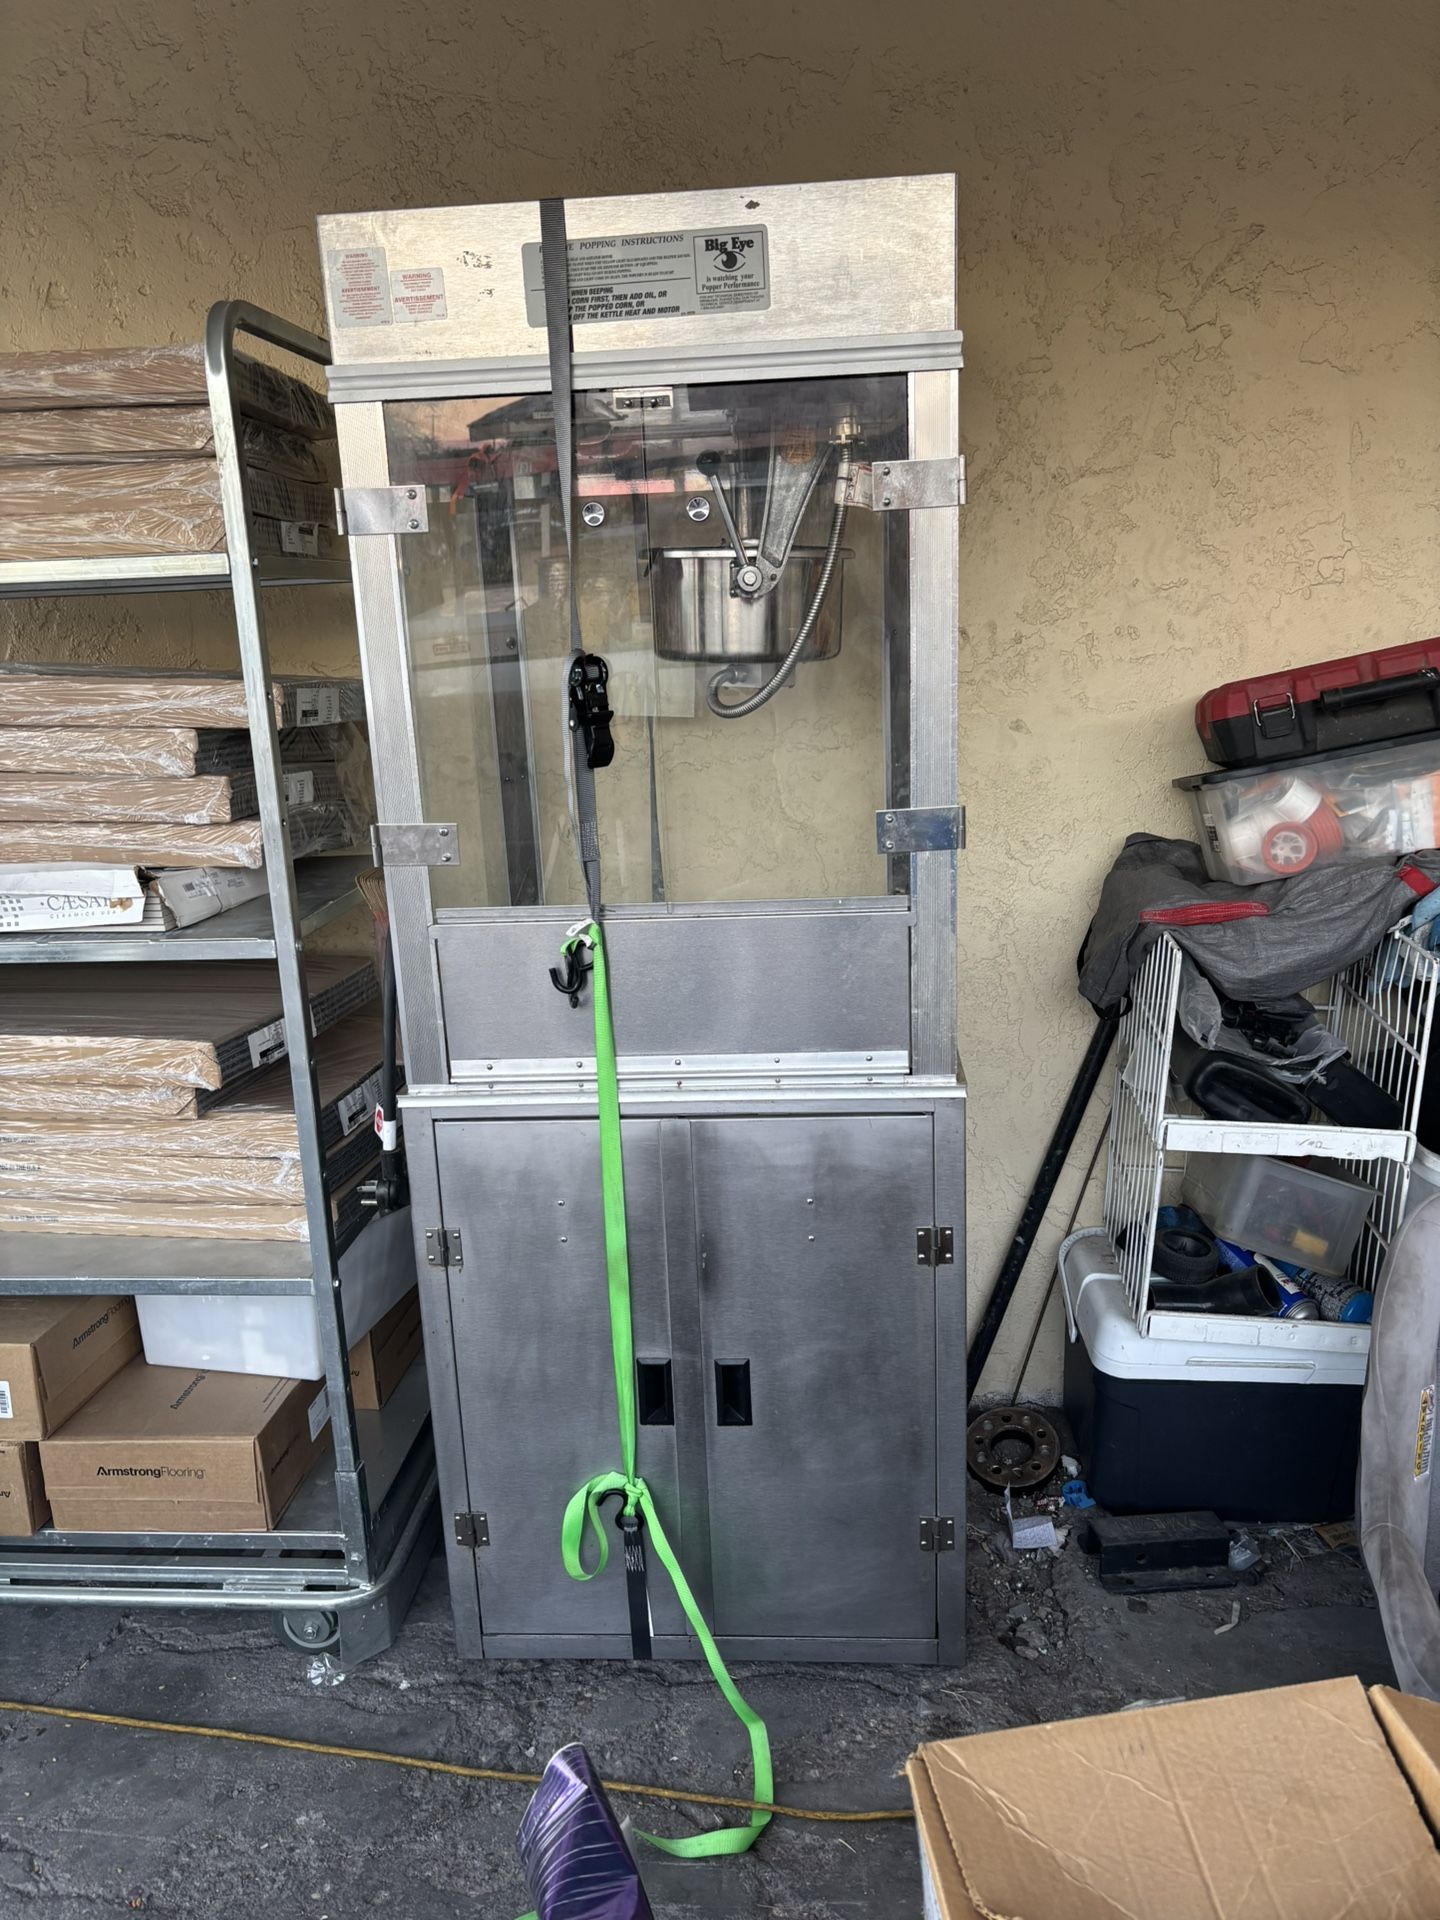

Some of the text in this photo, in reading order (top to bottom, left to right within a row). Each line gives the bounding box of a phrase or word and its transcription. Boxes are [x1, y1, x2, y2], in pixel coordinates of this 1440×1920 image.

[580, 239, 616, 250] POPPING
[621, 234, 684, 247] INSTRUCTIONS
[704, 236, 754, 254] Big Eye
[402, 272, 431, 280] WARNING
[713, 273, 738, 282] watching
[741, 273, 754, 281] your
[571, 286, 614, 296] WHEN BEEPING
[702, 281, 760, 293] Popper Performance
[571, 290, 667, 305] CORN FIRST, THEN ADD OIL, OR
[575, 300, 645, 312] THE POPPED CORN, OR
[587, 311, 599, 319] THE
[600, 310, 624, 318] KETTLE
[624, 308, 641, 317] HEAT
[642, 306, 656, 315] AND
[657, 305, 680, 314] MOTOR
[97, 1466, 204, 1479] ArmstrongFlooring
